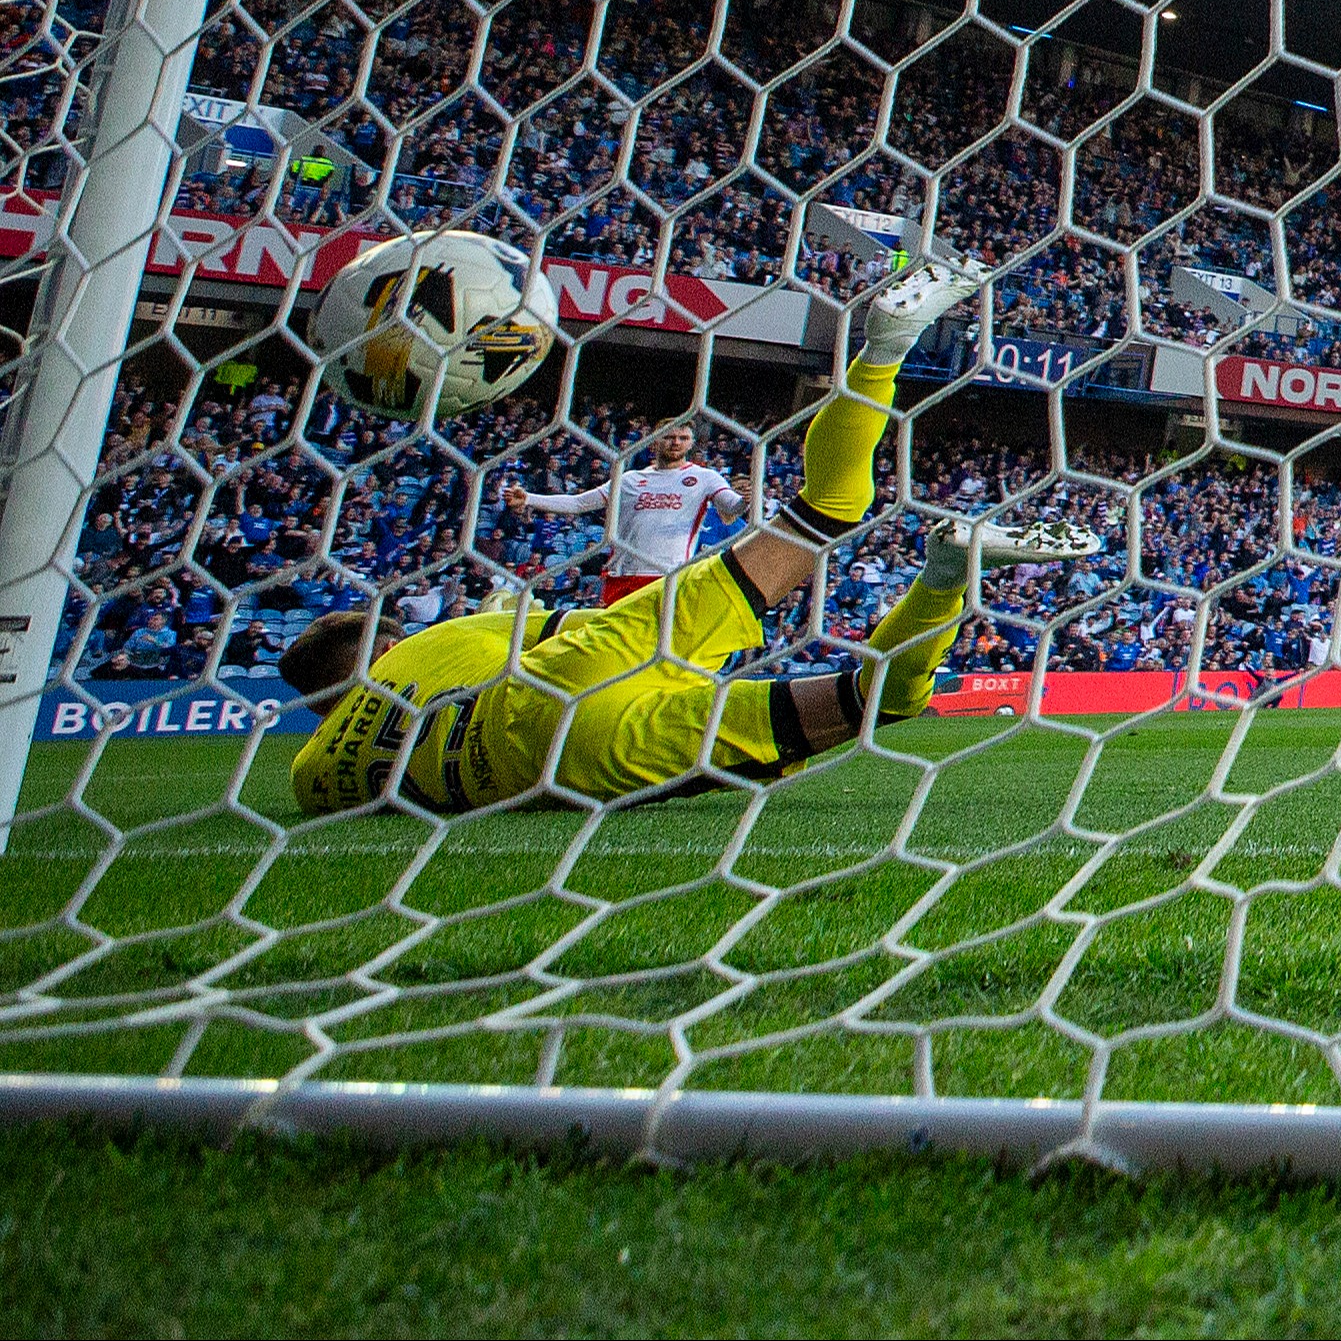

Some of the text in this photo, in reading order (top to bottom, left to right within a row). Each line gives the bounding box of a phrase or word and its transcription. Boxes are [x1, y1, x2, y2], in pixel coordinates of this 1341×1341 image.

[184, 96, 231, 119] XIT
[1219, 278, 1233, 290] 13
[972, 677, 1021, 691] BOXT
[51, 699, 282, 735] BOILERS
